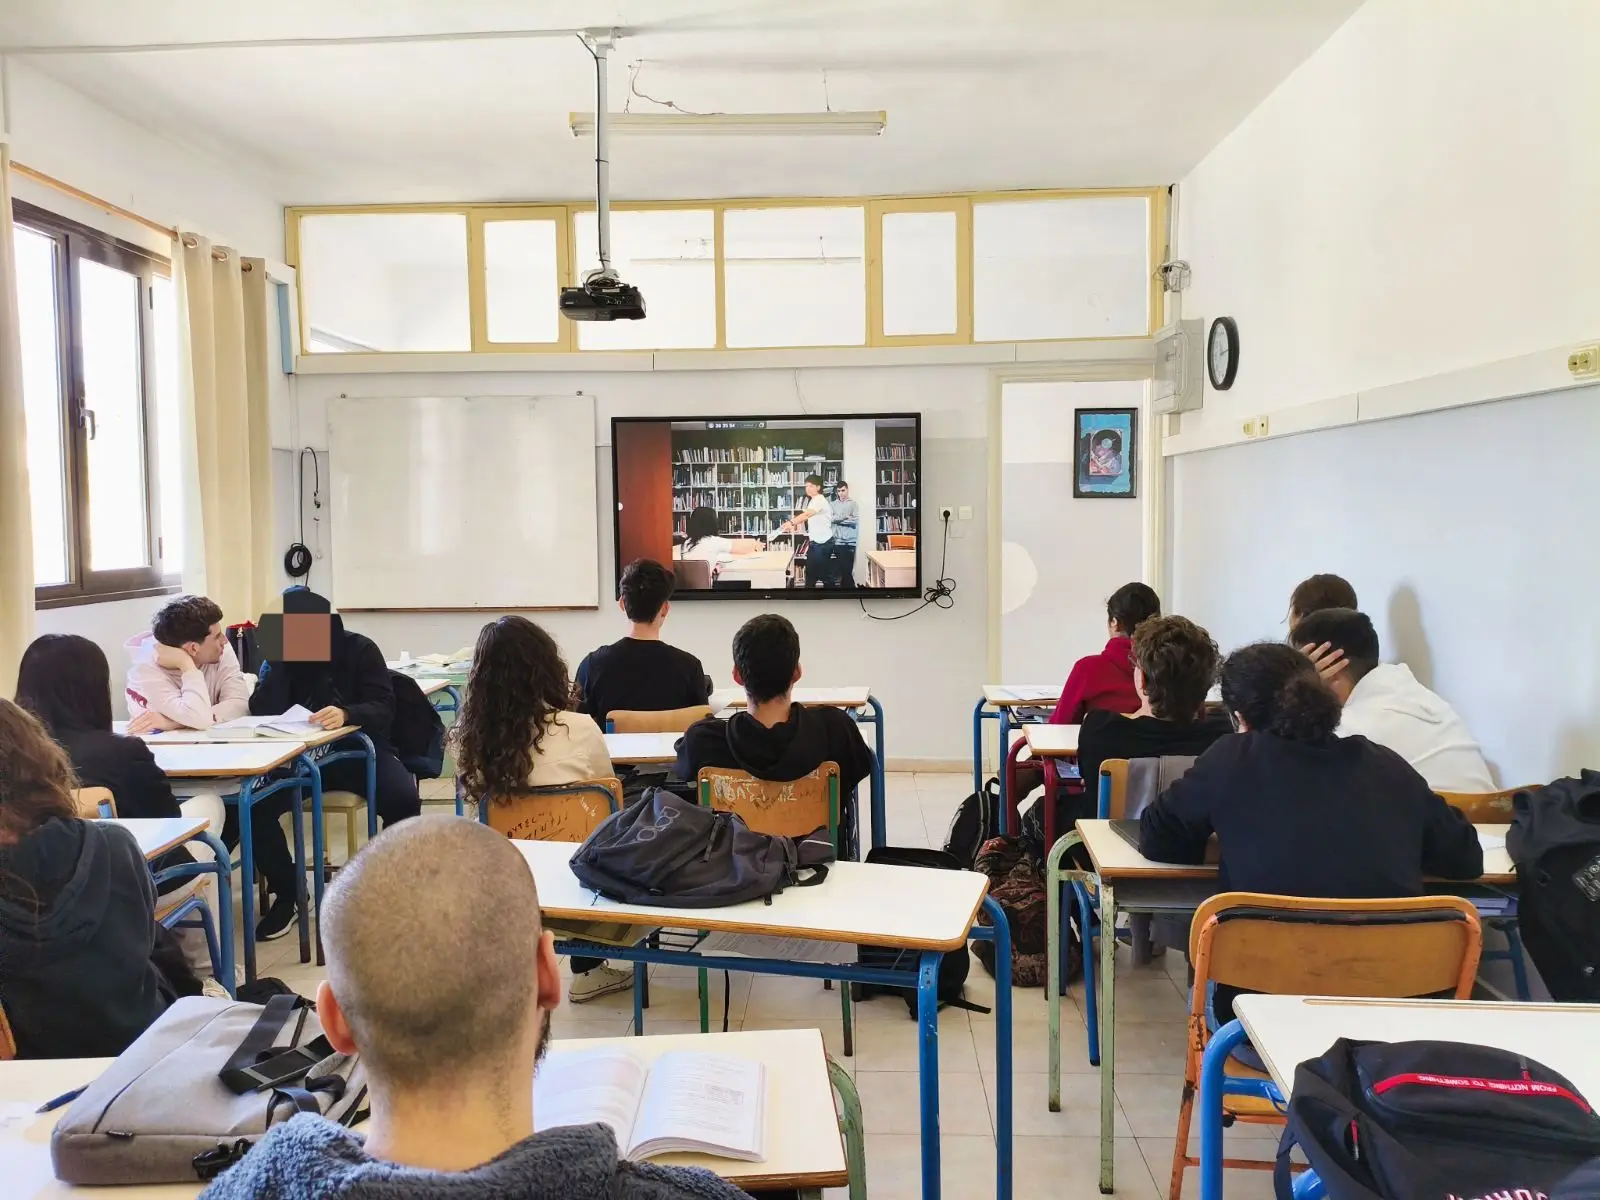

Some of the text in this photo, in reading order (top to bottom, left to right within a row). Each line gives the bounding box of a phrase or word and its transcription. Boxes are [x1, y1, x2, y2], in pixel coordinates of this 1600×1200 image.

[1418, 1075, 1470, 1086] SOMETHING
[1488, 1082, 1528, 1091] NOTHING
[1531, 1084, 1557, 1093] FROM
